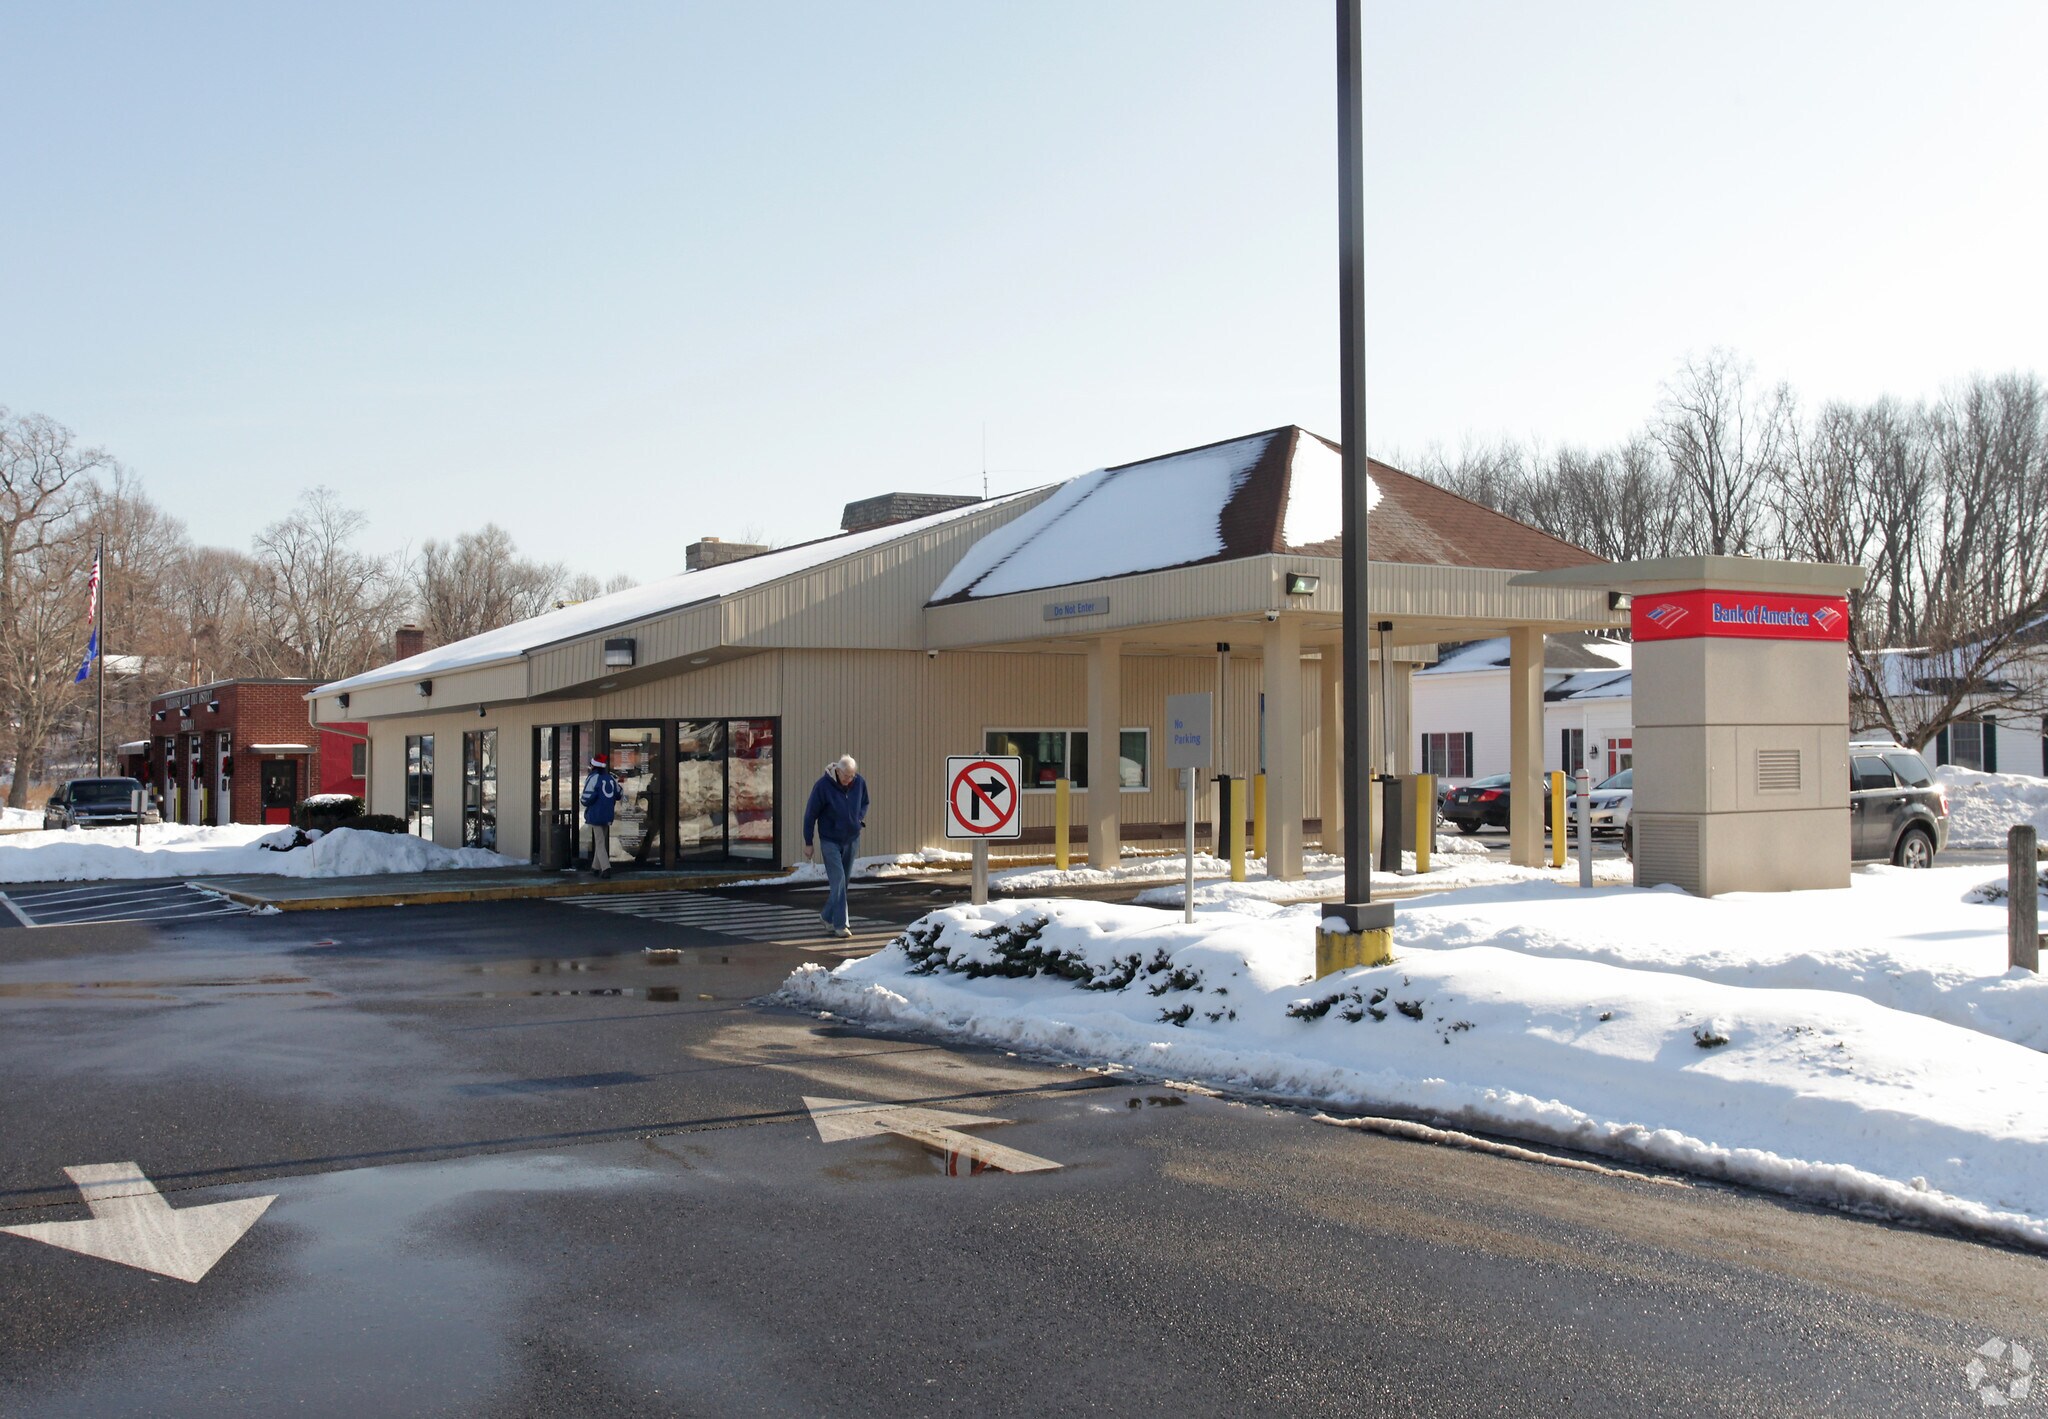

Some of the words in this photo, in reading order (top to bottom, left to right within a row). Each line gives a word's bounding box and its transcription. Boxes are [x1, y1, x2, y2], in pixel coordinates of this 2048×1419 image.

[1054, 606, 1063, 616] Do
[1065, 604, 1076, 615] Not
[1077, 603, 1095, 613] Enter
[1712, 603, 1745, 623] Bank
[1745, 605, 1759, 624] of
[1759, 606, 1810, 626] America
[1174, 720, 1184, 729] No
[1174, 733, 1201, 746] Parking
